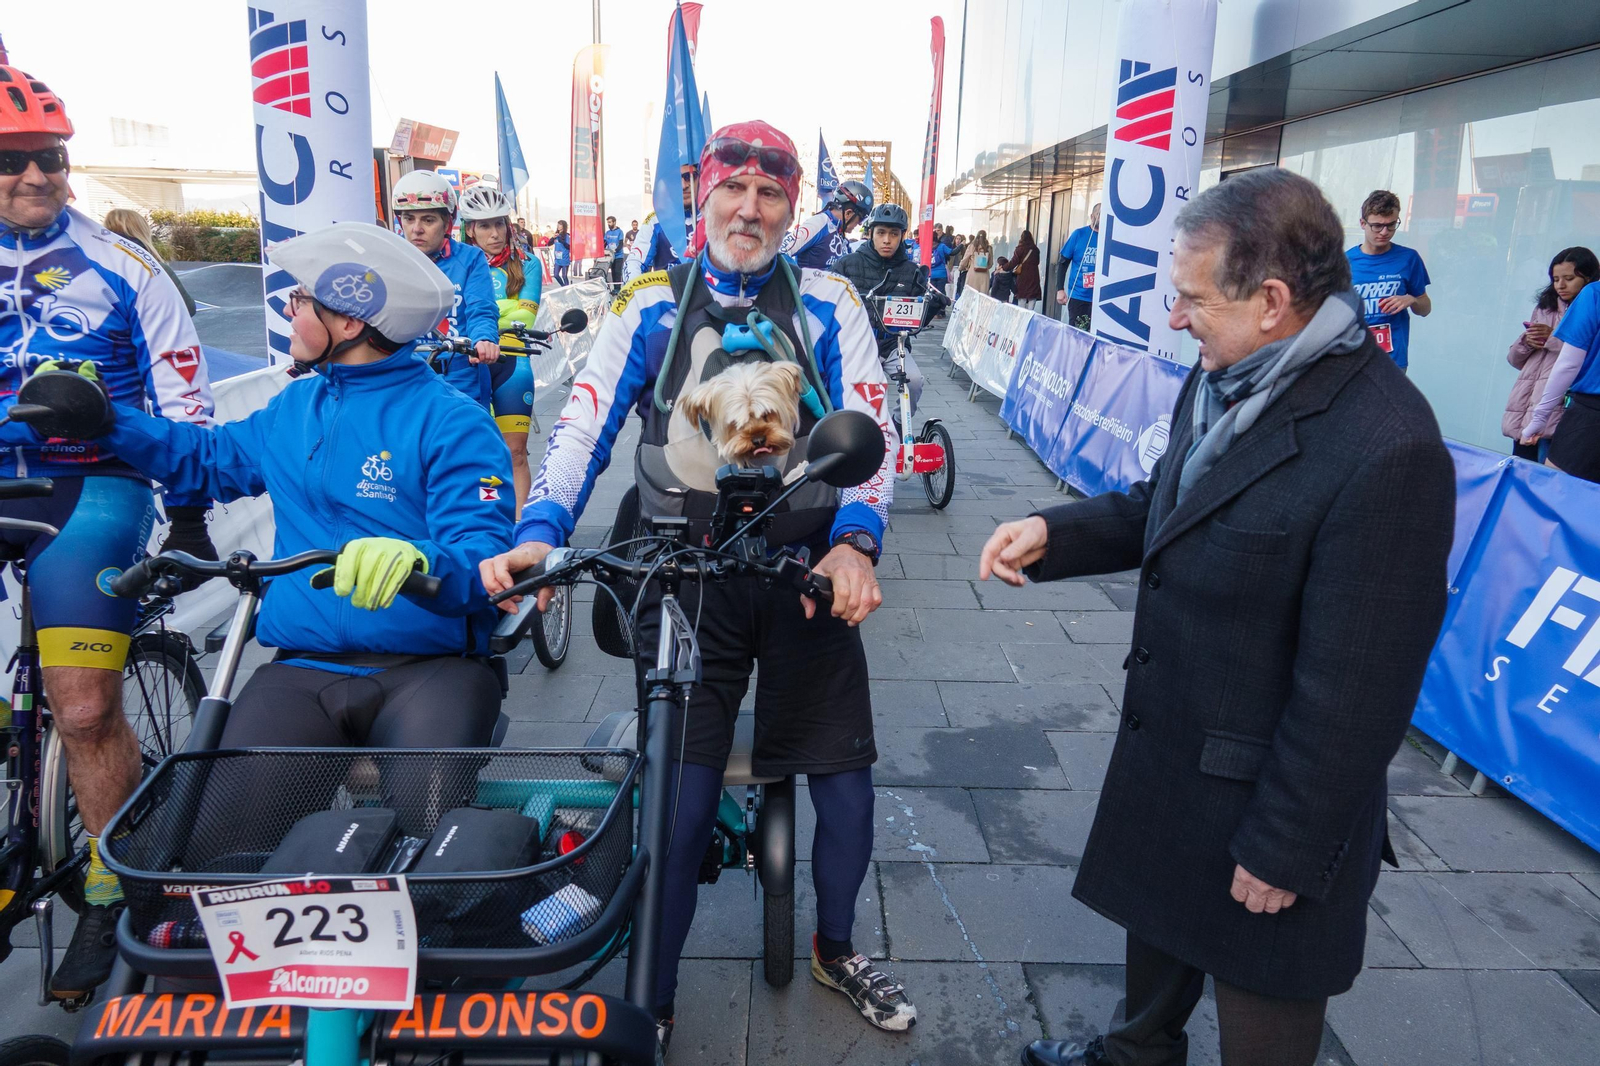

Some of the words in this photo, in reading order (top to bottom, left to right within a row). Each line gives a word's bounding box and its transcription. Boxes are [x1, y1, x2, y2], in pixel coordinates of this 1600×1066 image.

[520, 301, 538, 310] ZICO
[896, 304, 914, 316] 231
[515, 420, 530, 428] ZICO
[70, 641, 113, 653] ZICO
[335, 822, 360, 853] BTWIN
[435, 825, 459, 857] BTWIN
[266, 903, 369, 948] 223
[268, 968, 370, 999] Alcampo
[389, 992, 608, 1039] ALONSO
